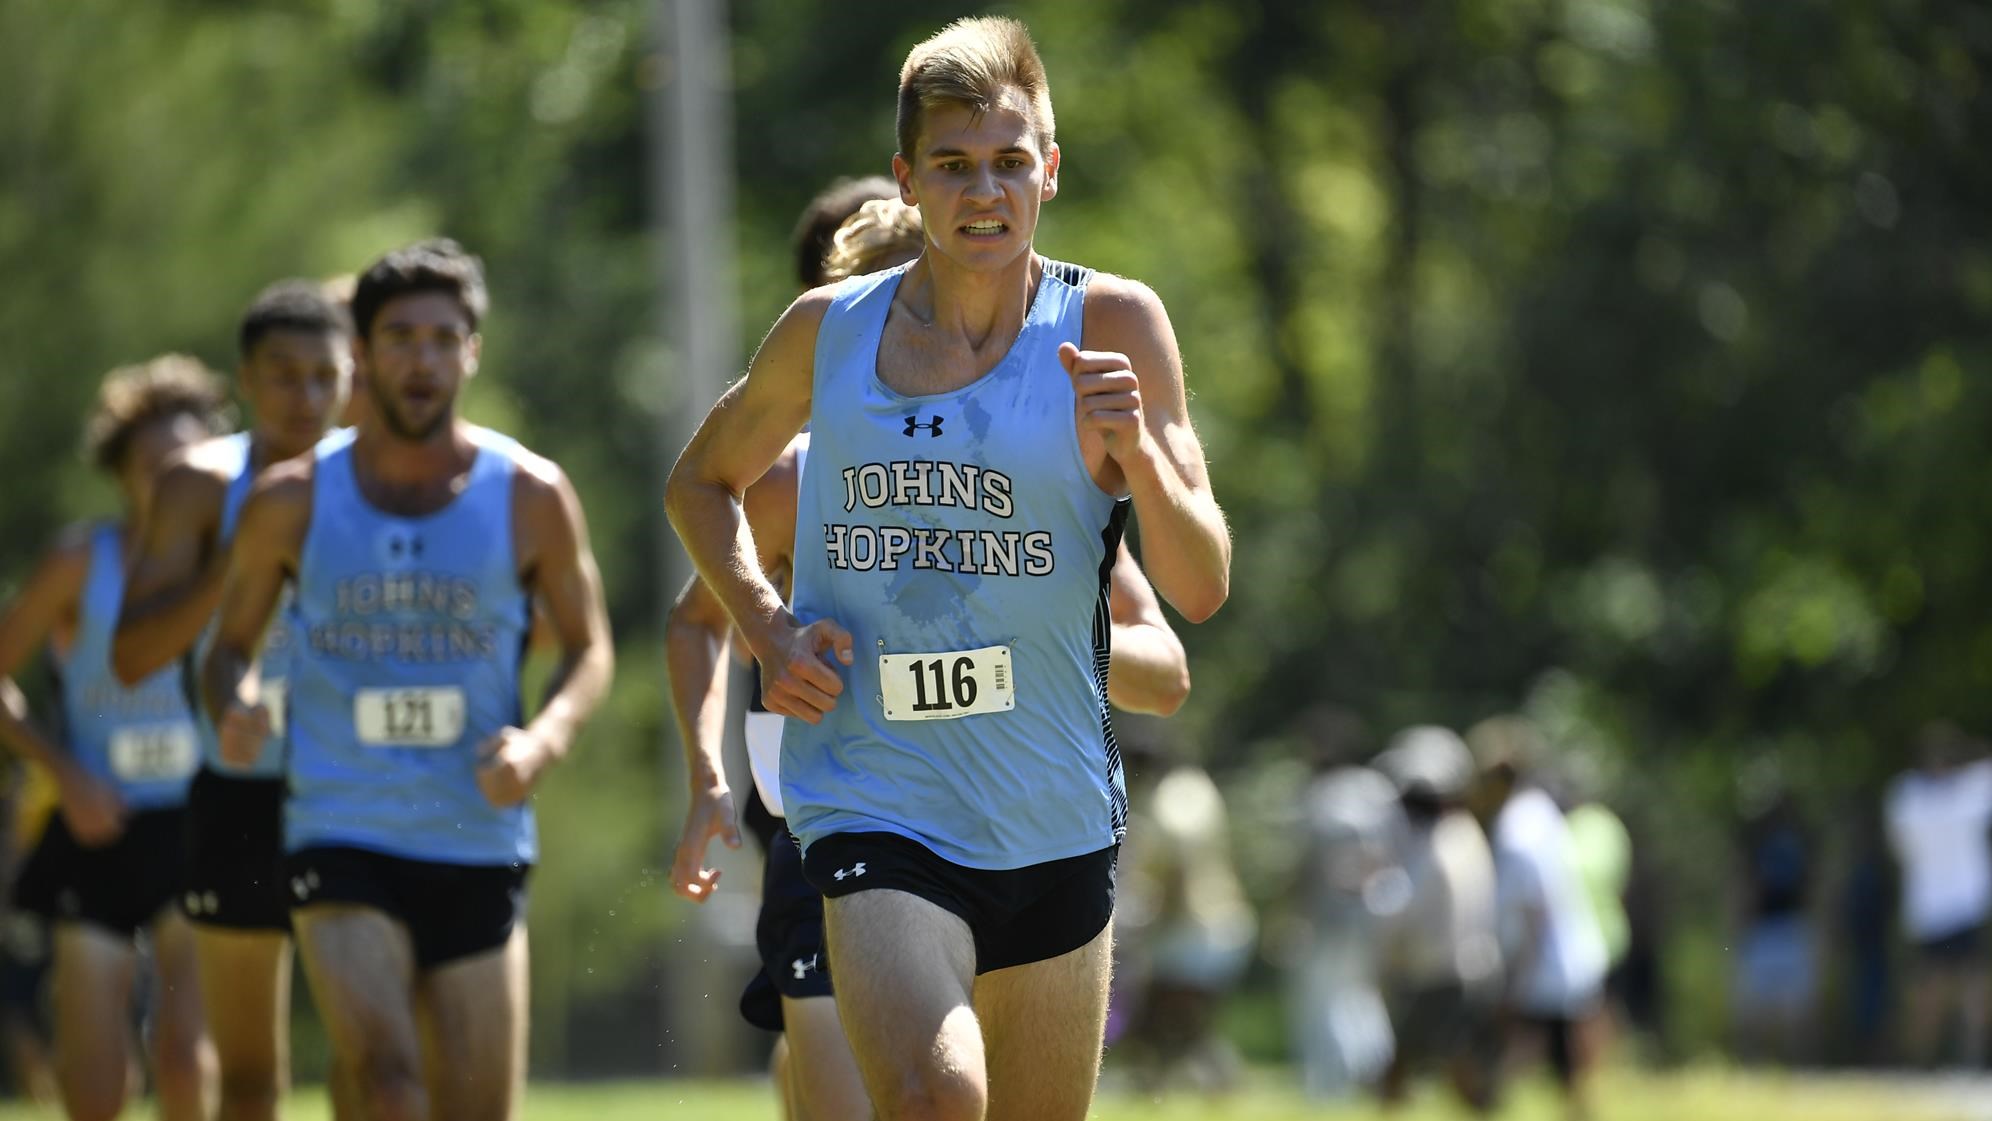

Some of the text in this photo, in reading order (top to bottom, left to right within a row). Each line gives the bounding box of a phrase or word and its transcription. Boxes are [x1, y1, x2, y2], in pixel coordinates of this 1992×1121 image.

[842, 460, 1014, 519] JOHNS
[824, 523, 1055, 576] HOPKINS
[336, 571, 477, 620] JOHNS
[312, 622, 497, 664] HOPKINS
[909, 656, 977, 711] 116
